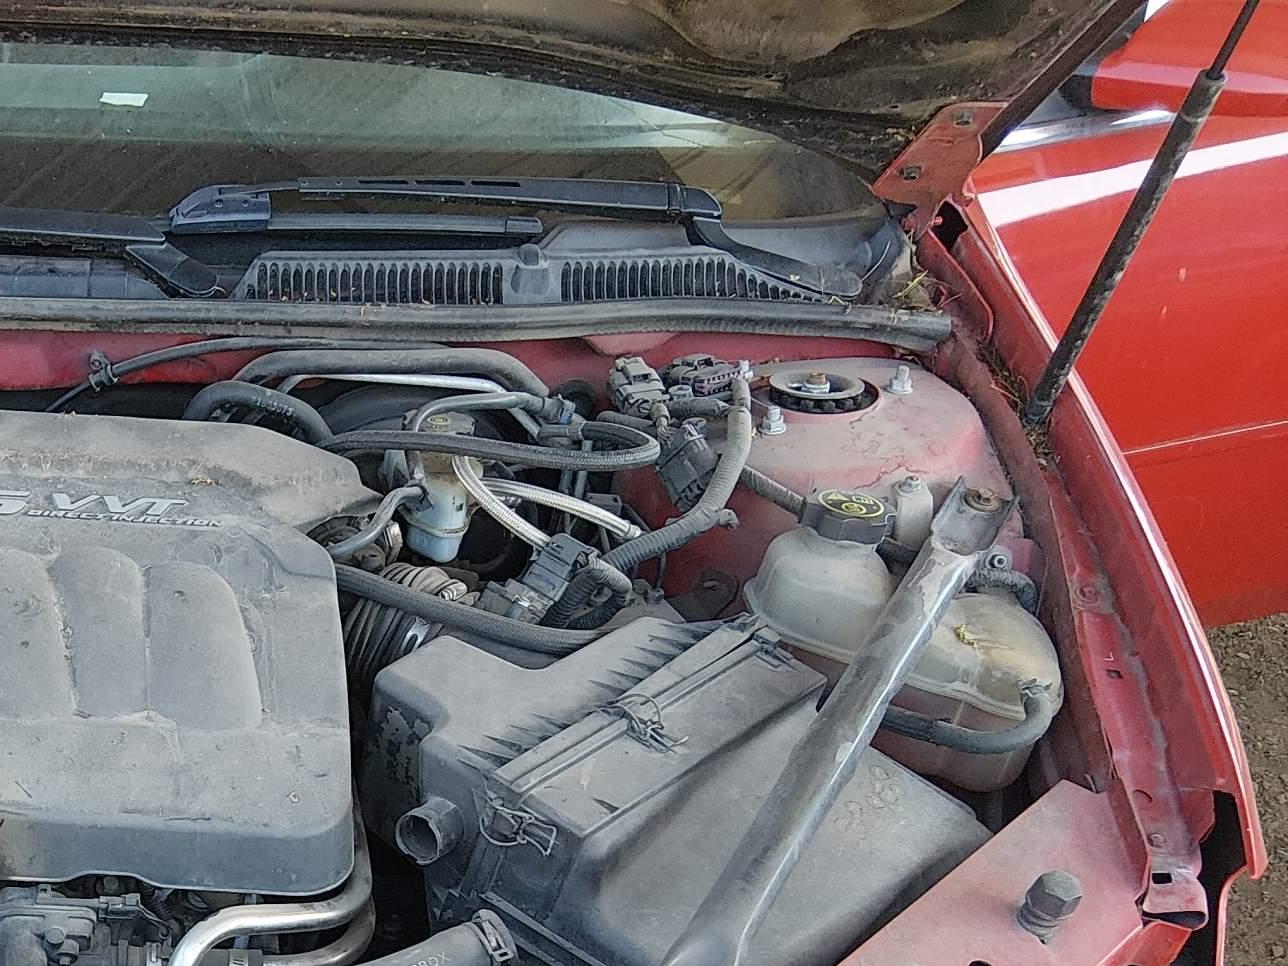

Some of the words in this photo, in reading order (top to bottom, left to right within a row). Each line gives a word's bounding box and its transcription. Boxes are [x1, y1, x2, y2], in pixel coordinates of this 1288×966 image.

[52, 492, 189, 516] VVT
[27, 509, 110, 520] DIRECT
[110, 513, 226, 527] INJECTION
